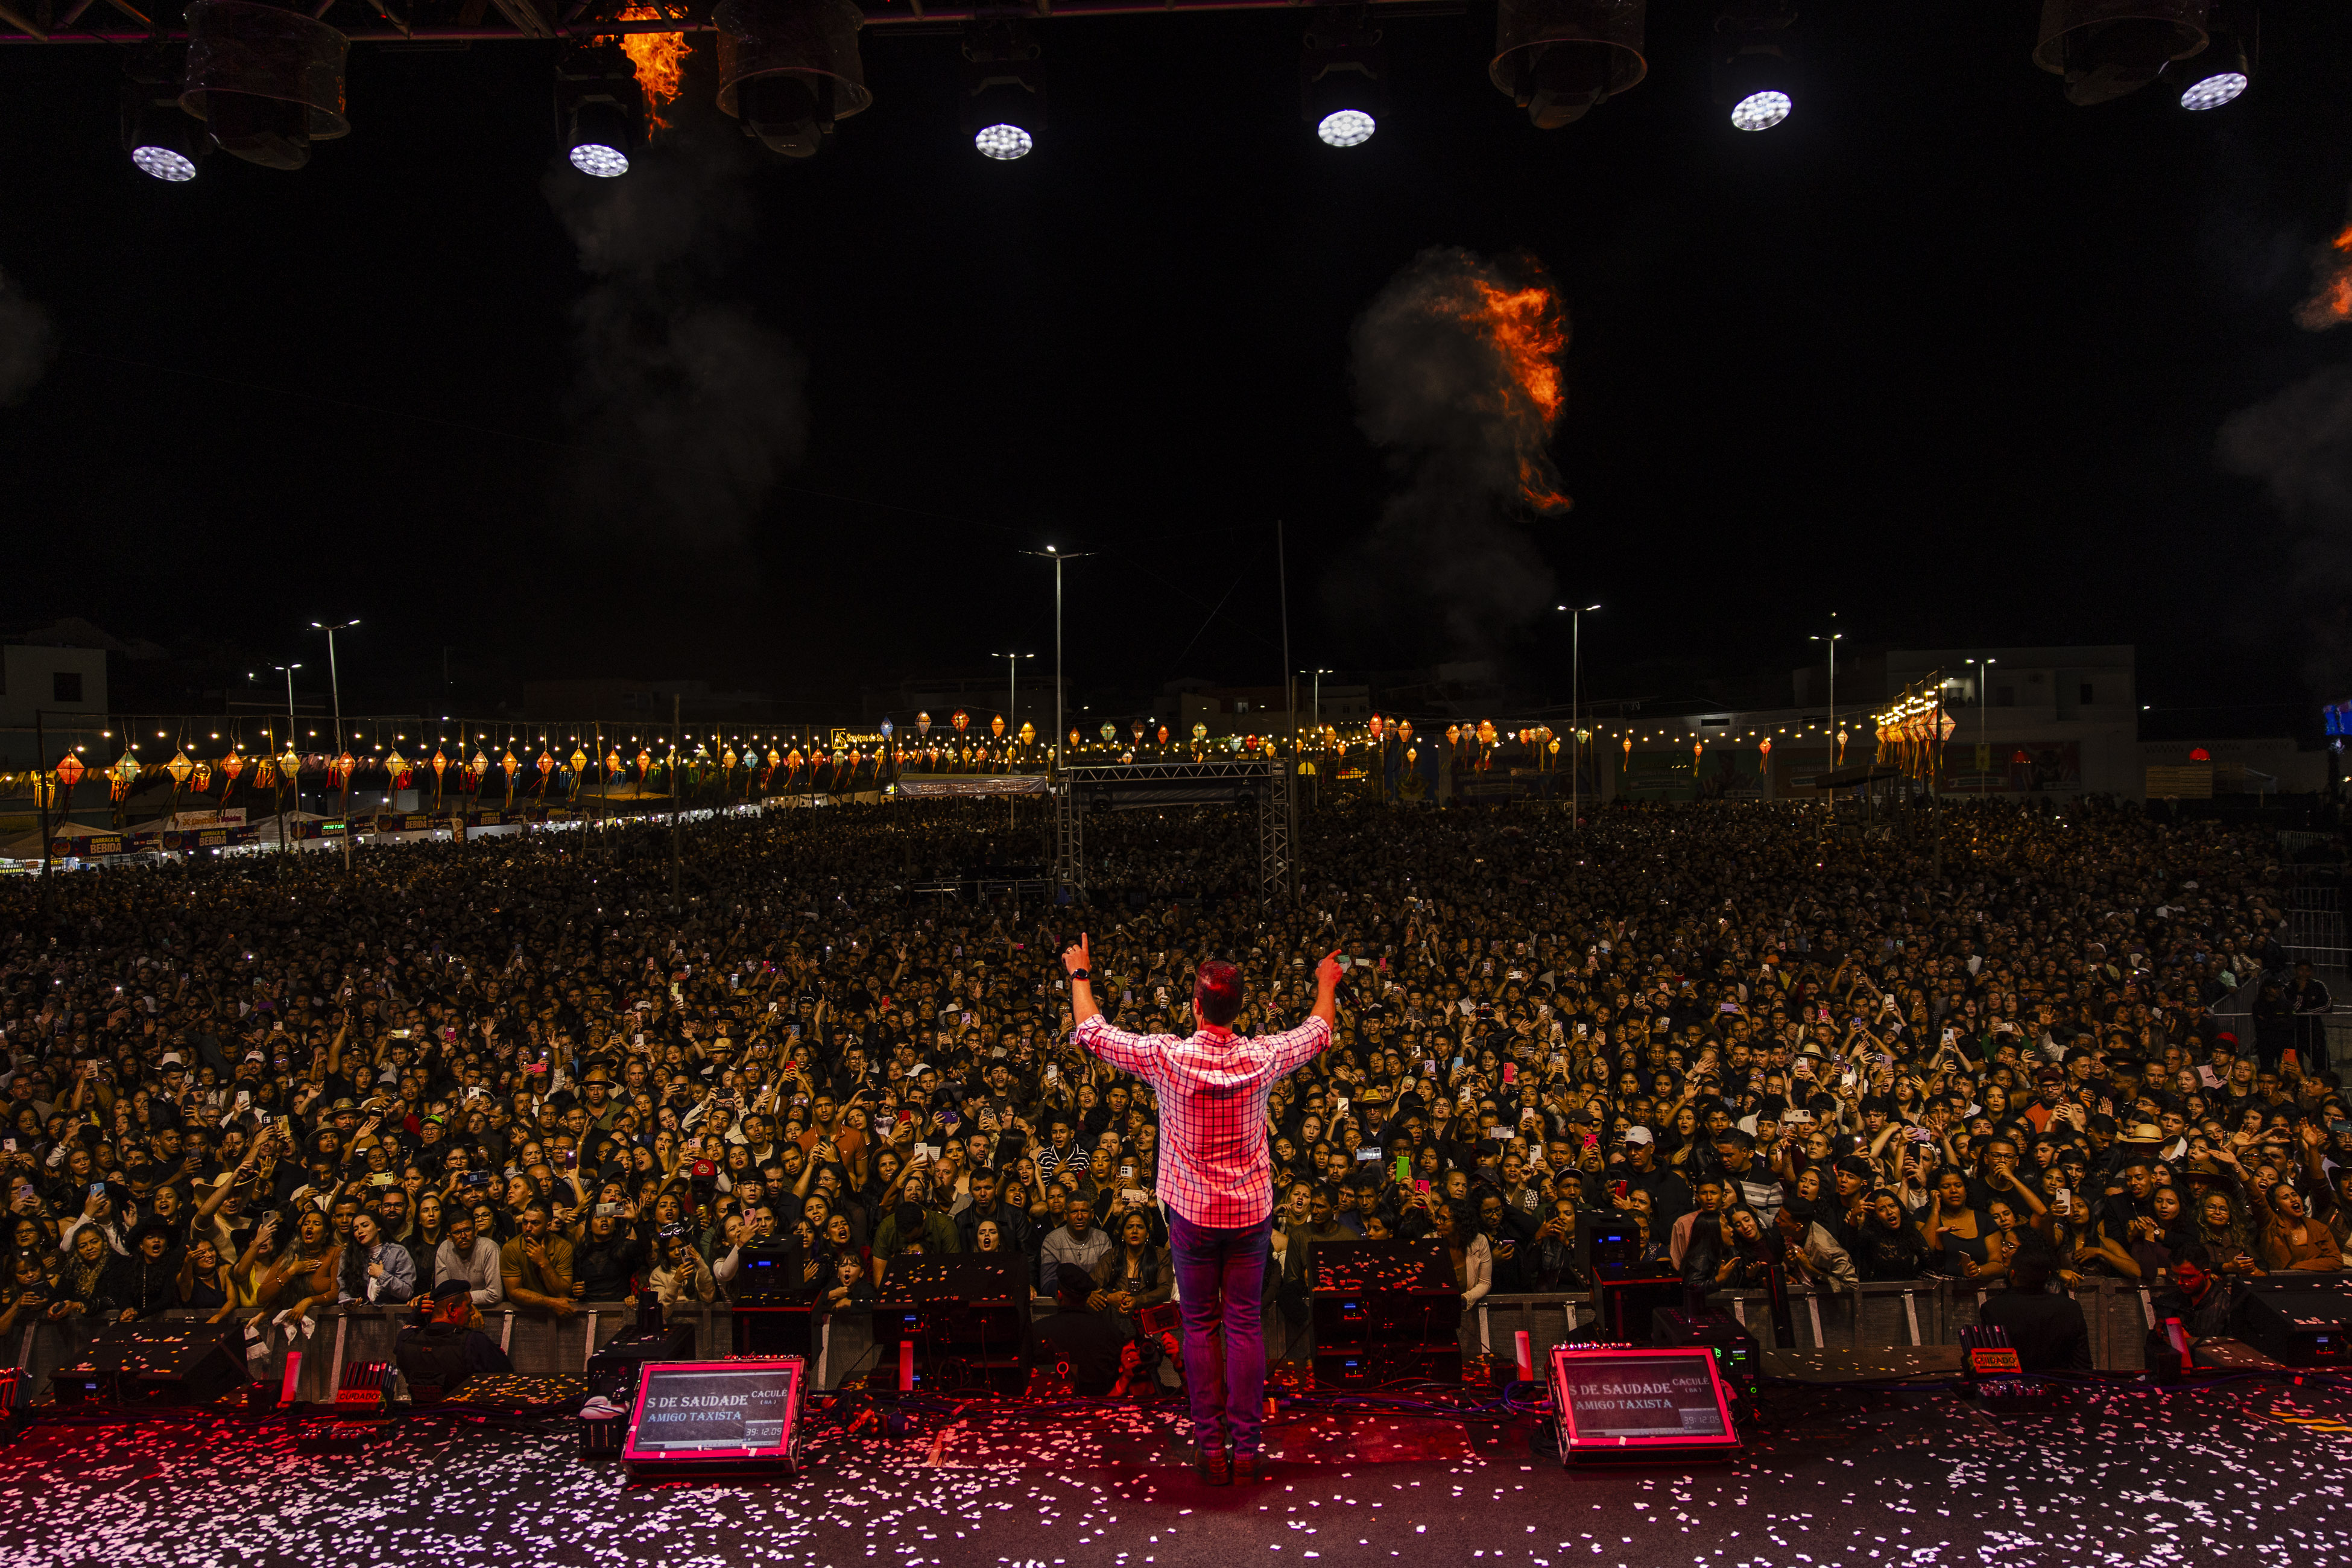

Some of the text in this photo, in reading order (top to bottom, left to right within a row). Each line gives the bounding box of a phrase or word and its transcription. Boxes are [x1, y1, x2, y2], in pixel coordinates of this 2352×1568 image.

[847, 733, 868, 743] Serviços
[869, 733, 876, 742] de
[405, 820, 427, 829] BEBIDA
[199, 835, 227, 846] BEBIDA
[90, 842, 121, 855] BEBIDA
[1672, 1376, 1709, 1386] CACULÉ
[751, 1388, 788, 1398] CACULÉ
[1569, 1383, 1673, 1396] S DE SAUDADE
[647, 1395, 748, 1408] S DE SAUDADE
[1576, 1399, 1673, 1410] AMIGO TAXISTA
[647, 1411, 742, 1422] AMIGO TAXISTA
